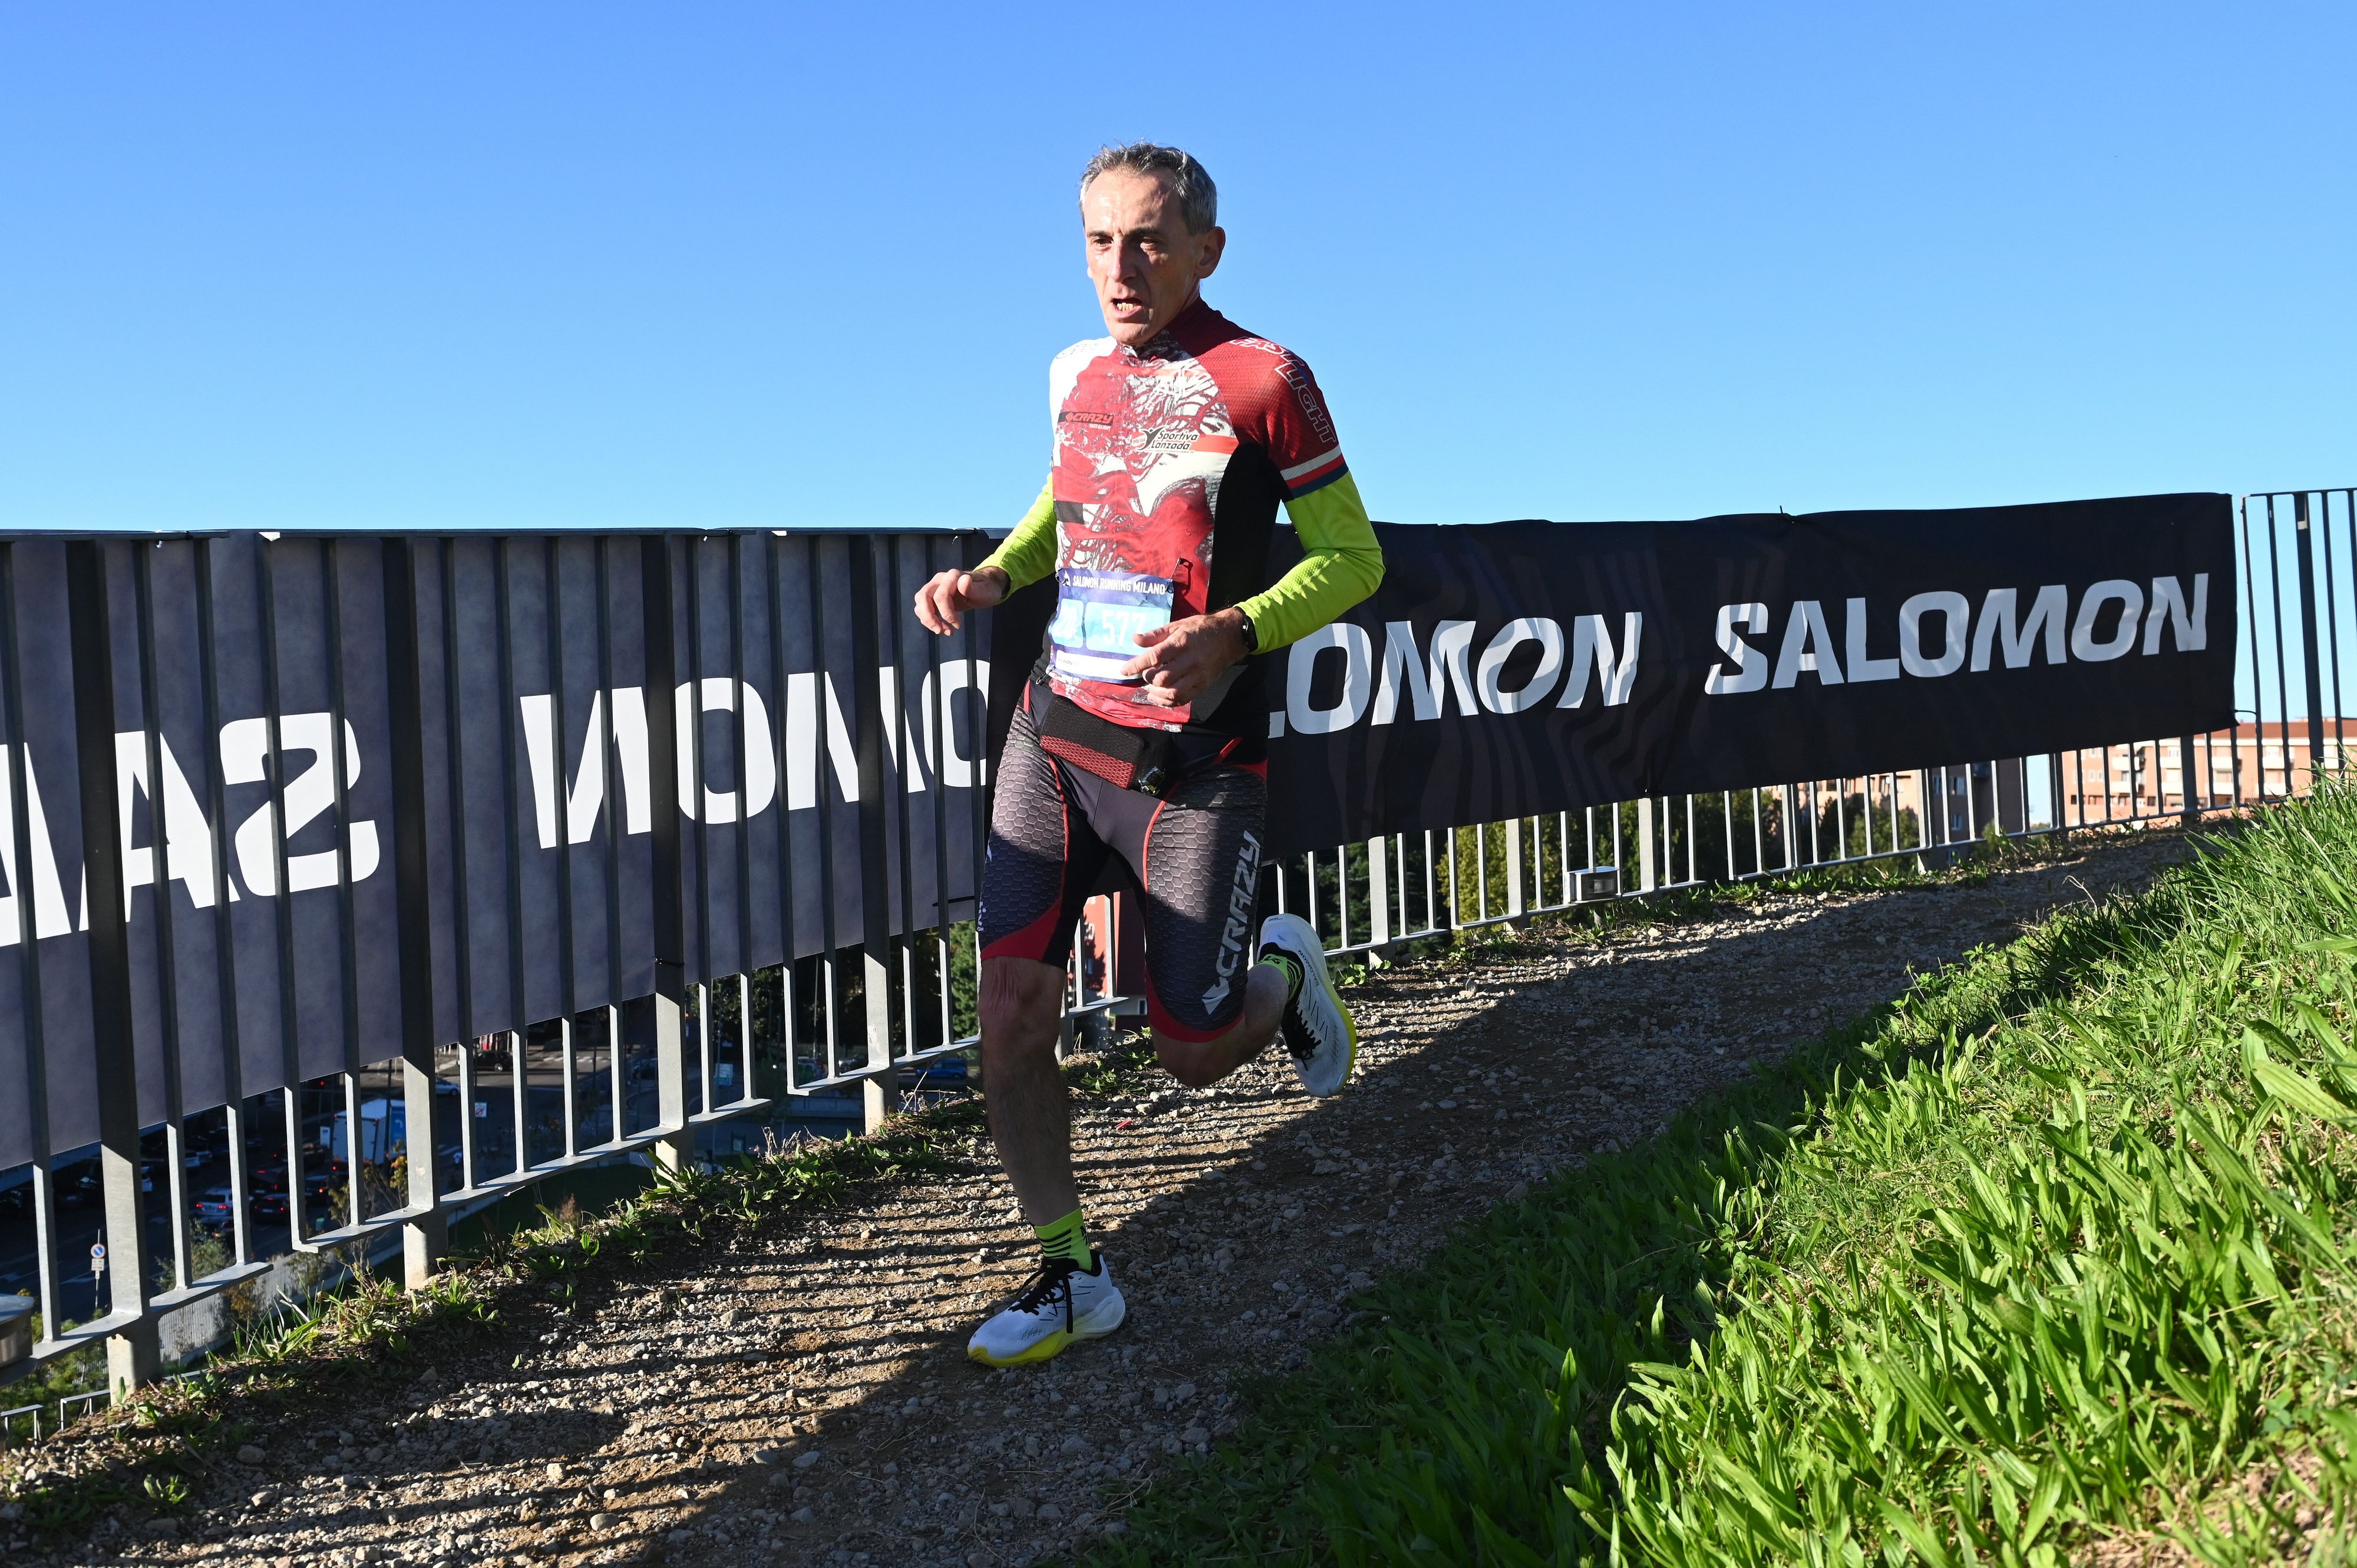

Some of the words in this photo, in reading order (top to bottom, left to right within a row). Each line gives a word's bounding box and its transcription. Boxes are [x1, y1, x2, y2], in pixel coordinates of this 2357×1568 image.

[1274, 362, 1336, 443] LIGHT
[1072, 412, 1113, 424] CRAZY
[1151, 440, 1190, 450] Lanzada
[1158, 430, 1199, 441] Sportiva
[1072, 575, 1098, 589] SALOMON
[1100, 577, 1131, 592] RUNNING
[1133, 581, 1166, 595] MILANO
[1268, 612, 1642, 738] OMON
[1704, 573, 2209, 695] SALOMON
[1216, 830, 1260, 977] CRAZY
[1298, 950, 1319, 986] SALOMON
